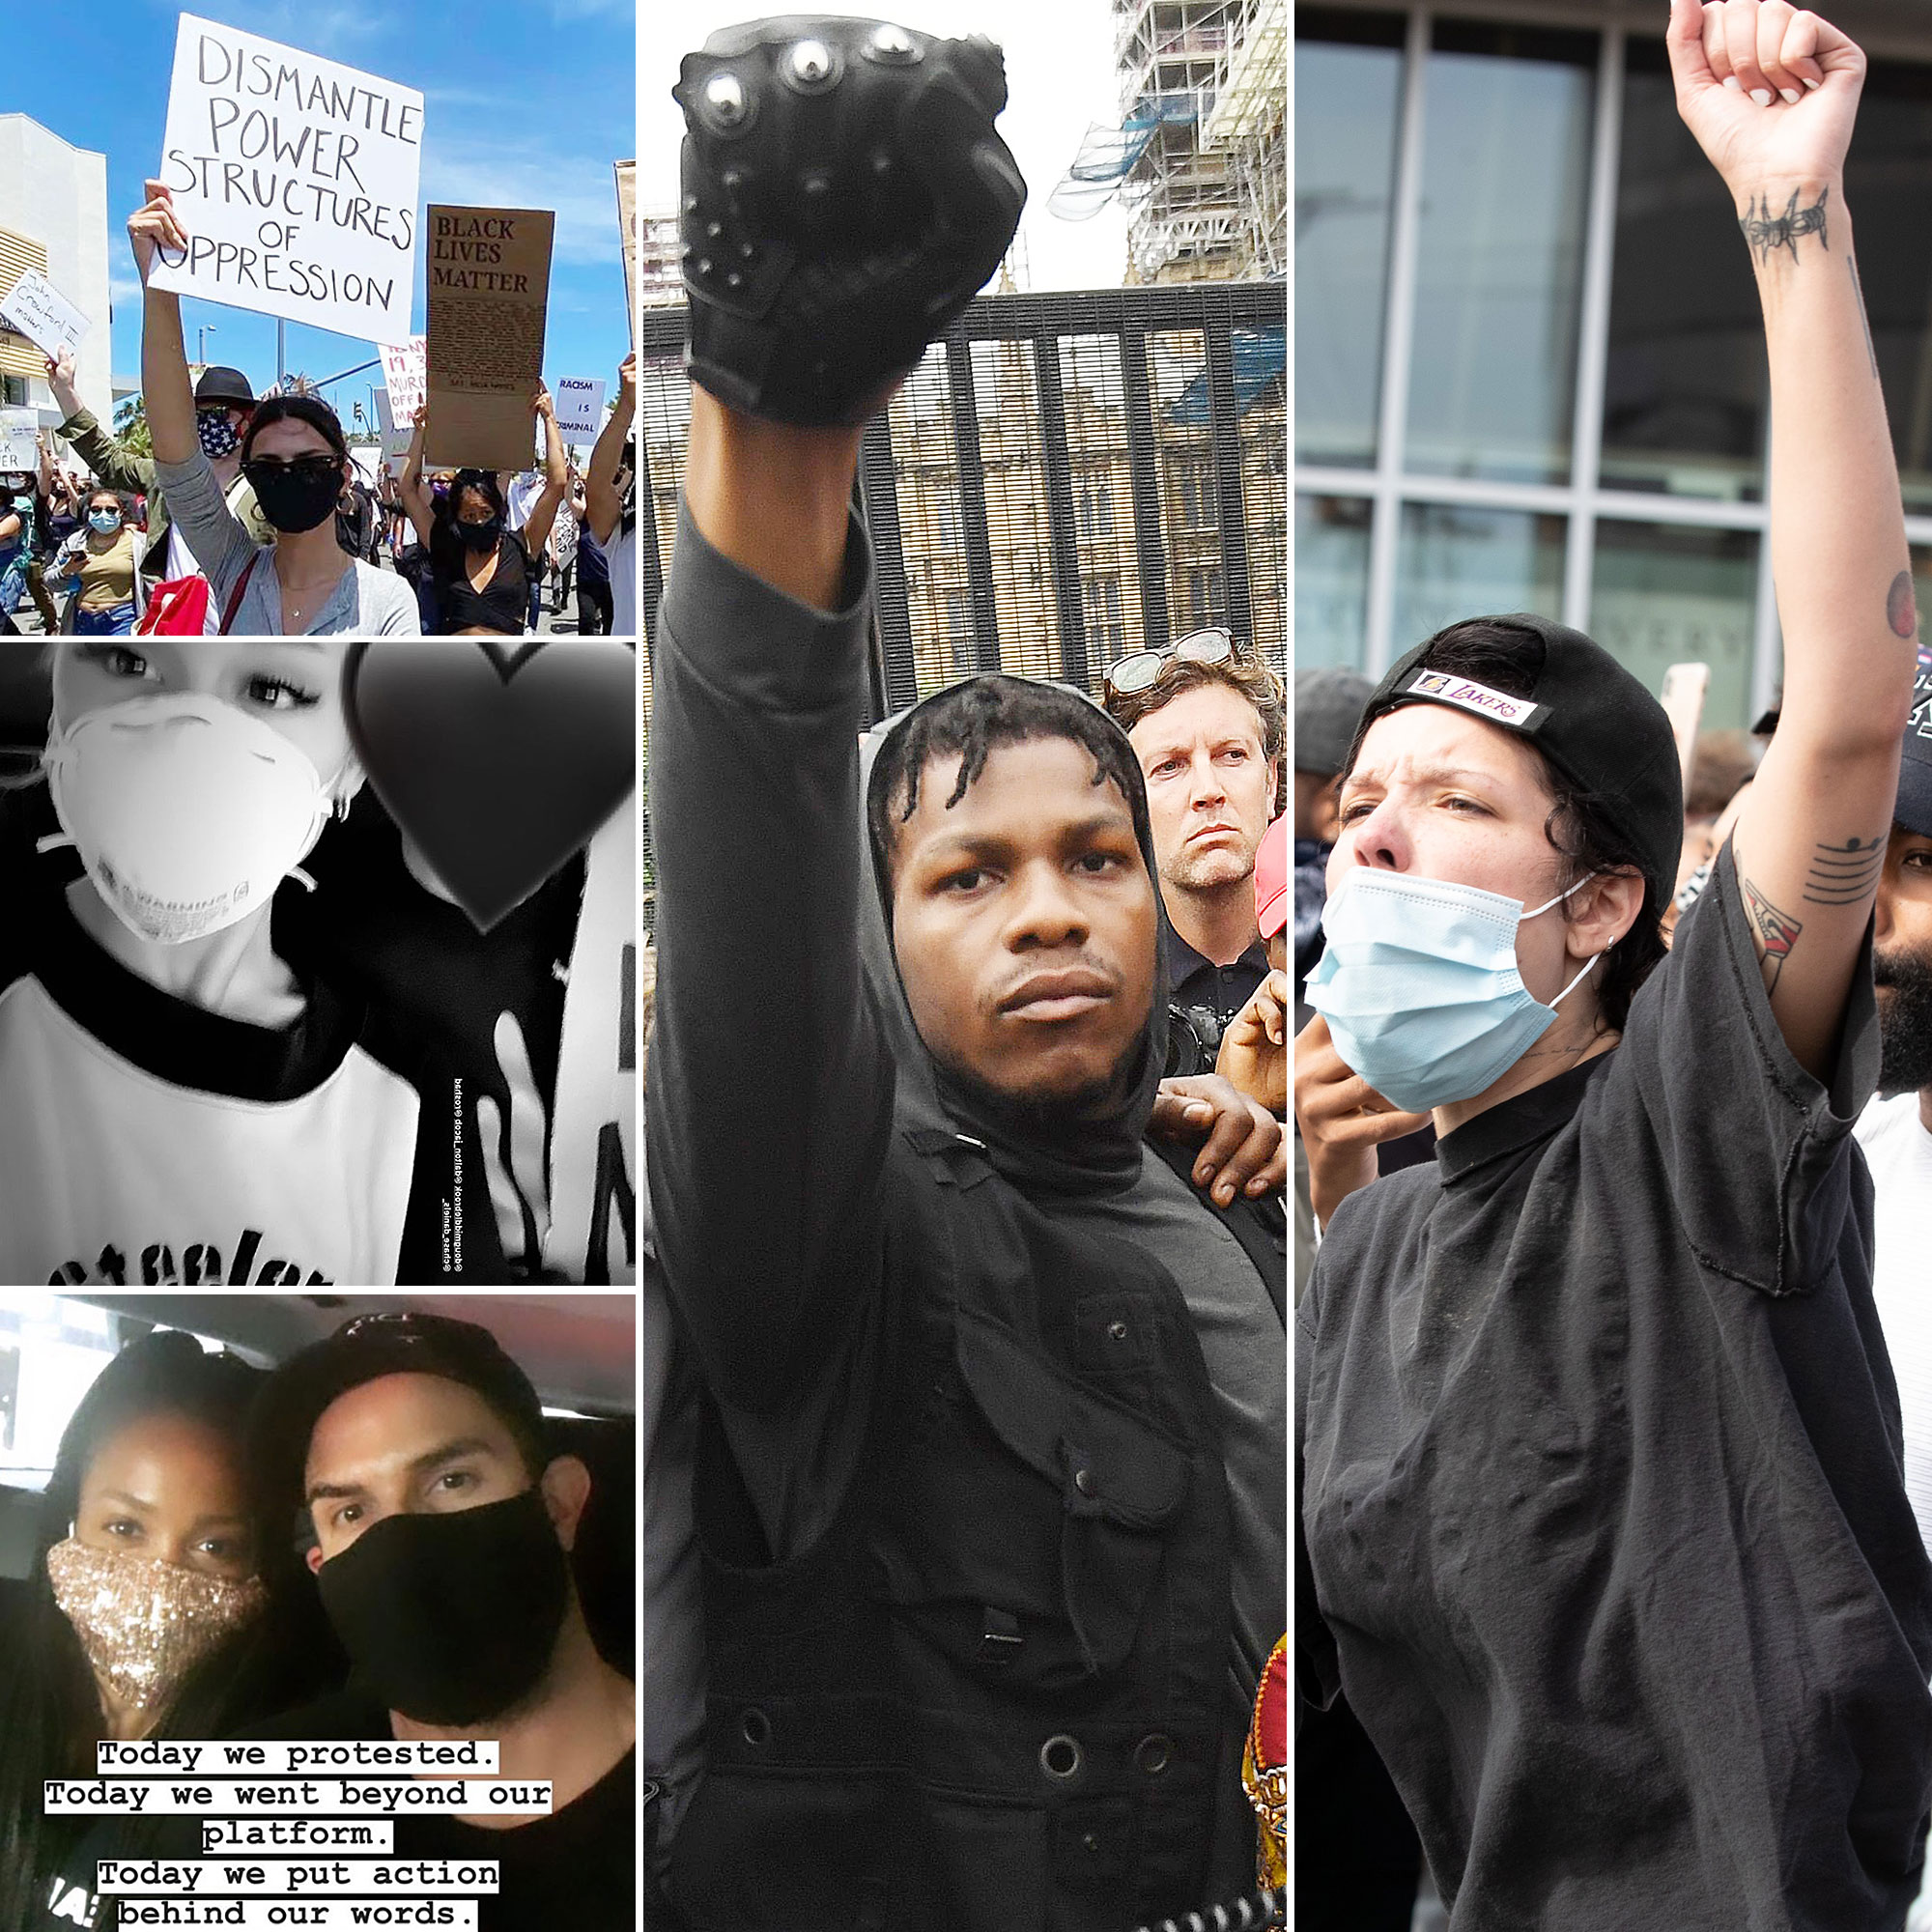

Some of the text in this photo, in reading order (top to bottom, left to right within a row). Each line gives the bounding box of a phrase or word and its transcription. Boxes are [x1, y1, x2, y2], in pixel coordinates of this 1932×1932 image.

[199, 35, 422, 144] DISMANTLE
[210, 98, 365, 193] POWER
[168, 150, 412, 250] STRUCTURES
[258, 221, 299, 251] OF
[437, 215, 515, 240] BLACK
[434, 240, 500, 264] LIVES
[28, 273, 50, 301] John
[156, 235, 393, 311] OPPRESSION
[434, 267, 528, 294] MATTER
[578, 404, 589, 412] IS
[1446, 684, 1520, 717] LAKERS
